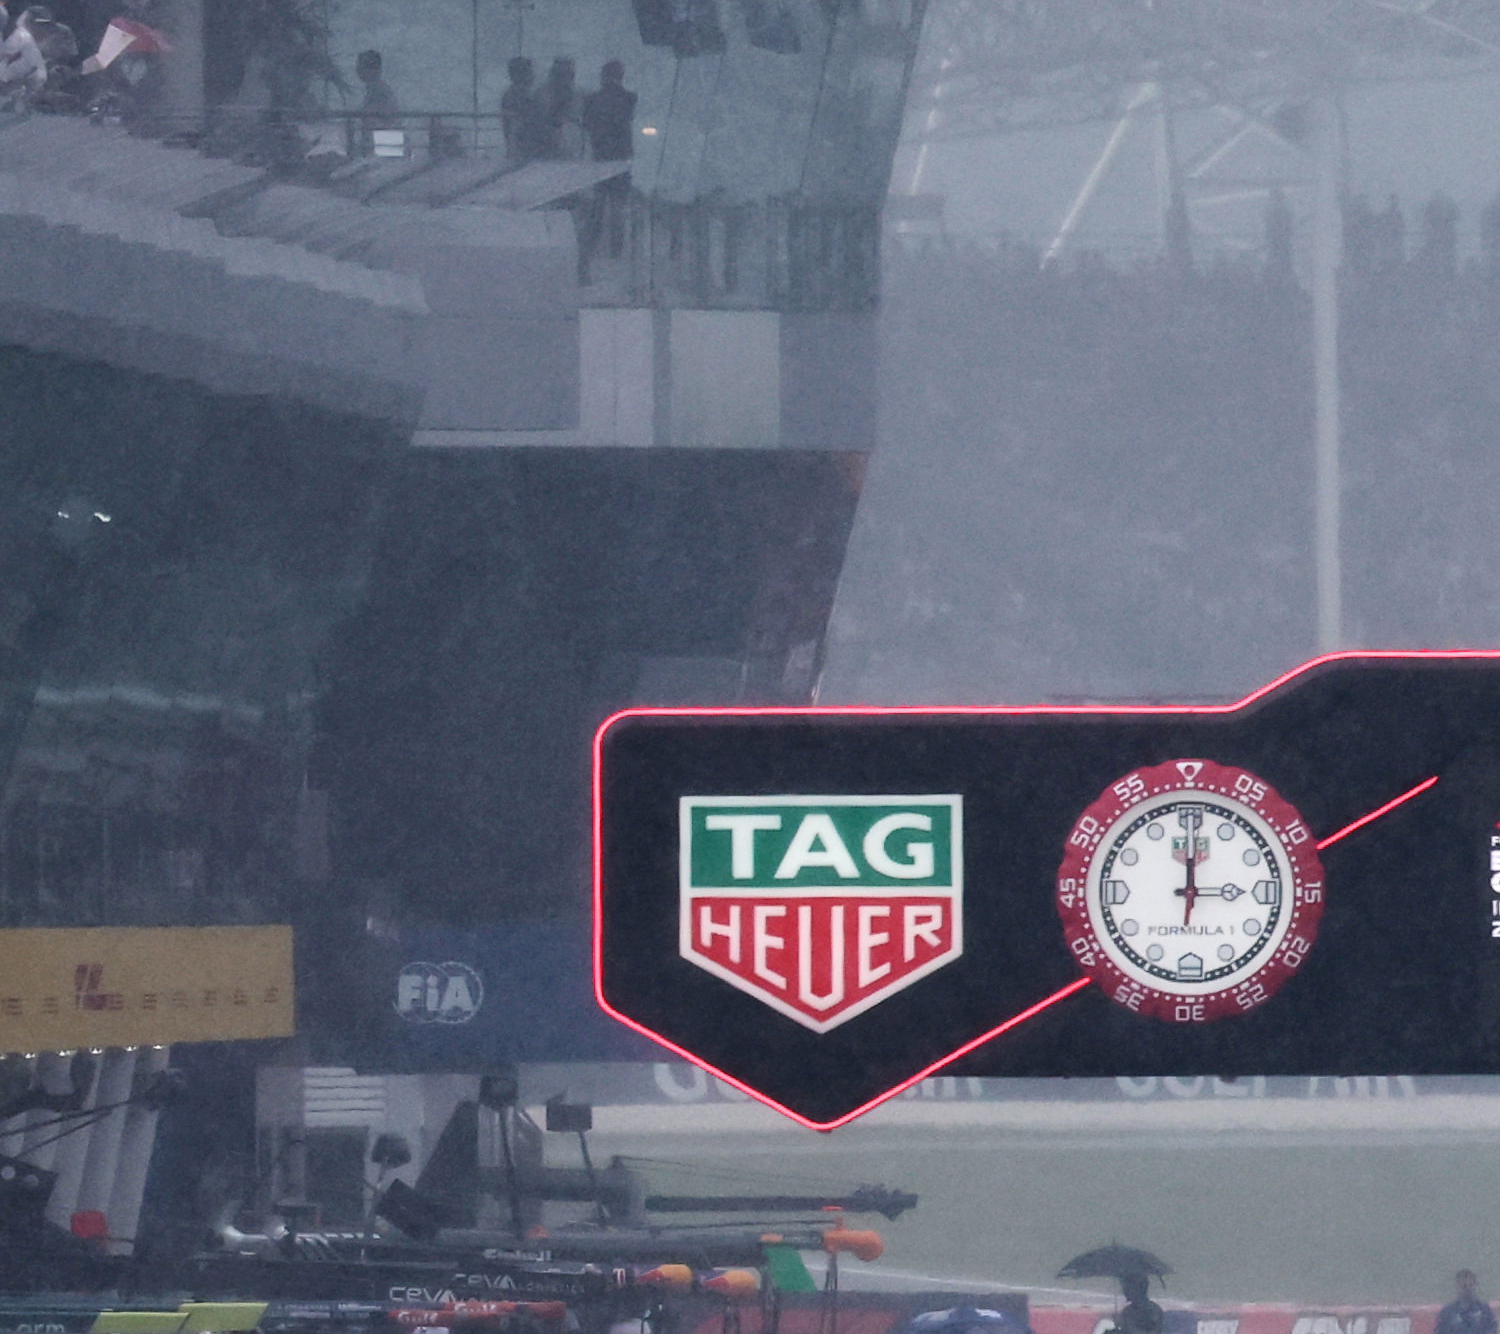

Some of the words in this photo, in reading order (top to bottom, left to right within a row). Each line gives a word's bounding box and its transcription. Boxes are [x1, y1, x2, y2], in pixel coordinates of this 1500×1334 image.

[1113, 774, 1145, 801] 55
[1234, 774, 1268, 802] 05
[706, 812, 935, 880] TAG
[1070, 816, 1099, 848] 50
[1286, 819, 1308, 845] 10
[1059, 878, 1076, 909] 45
[1304, 881, 1321, 904] 15
[1147, 925, 1223, 937] FORMULA
[699, 904, 943, 1012] HEUER
[1071, 937, 1096, 967] 40
[1283, 937, 1311, 967] 20
[1114, 984, 1146, 1011] 35
[1237, 984, 1268, 1010] 25
